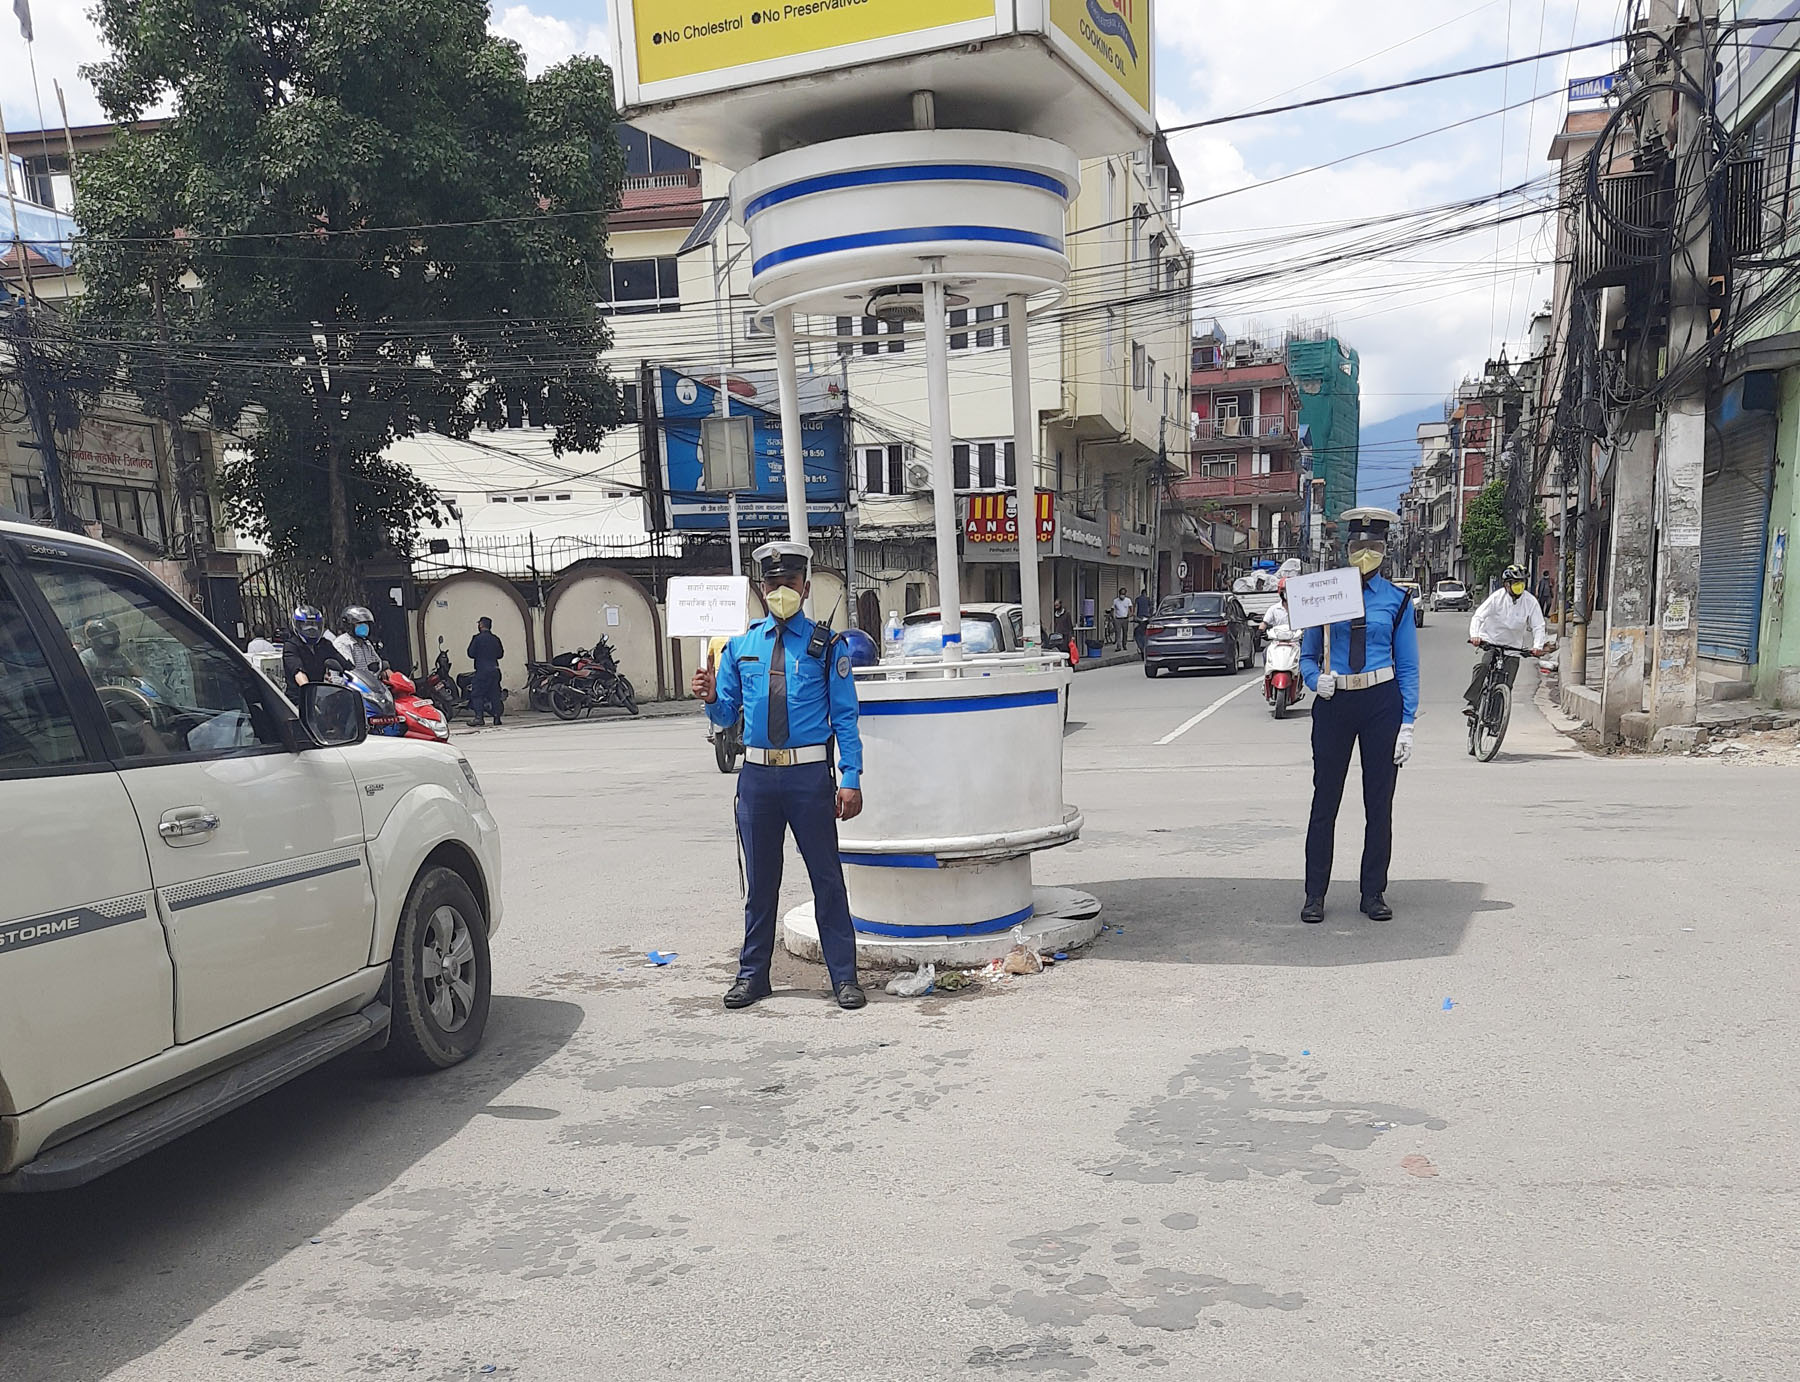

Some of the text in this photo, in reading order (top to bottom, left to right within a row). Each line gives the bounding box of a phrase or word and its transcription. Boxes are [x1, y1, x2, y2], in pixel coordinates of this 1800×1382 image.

[662, 30, 680, 43] No
[683, 15, 744, 40] Cholestrol
[762, 10, 780, 23] No
[1079, 18, 1114, 63] COOKING
[1114, 54, 1127, 77] OIL
[1571, 79, 1607, 97] HIMAL
[809, 449, 825, 457] 8:50
[967, 520, 1053, 532] ANGN
[31, 544, 58, 555] Safari
